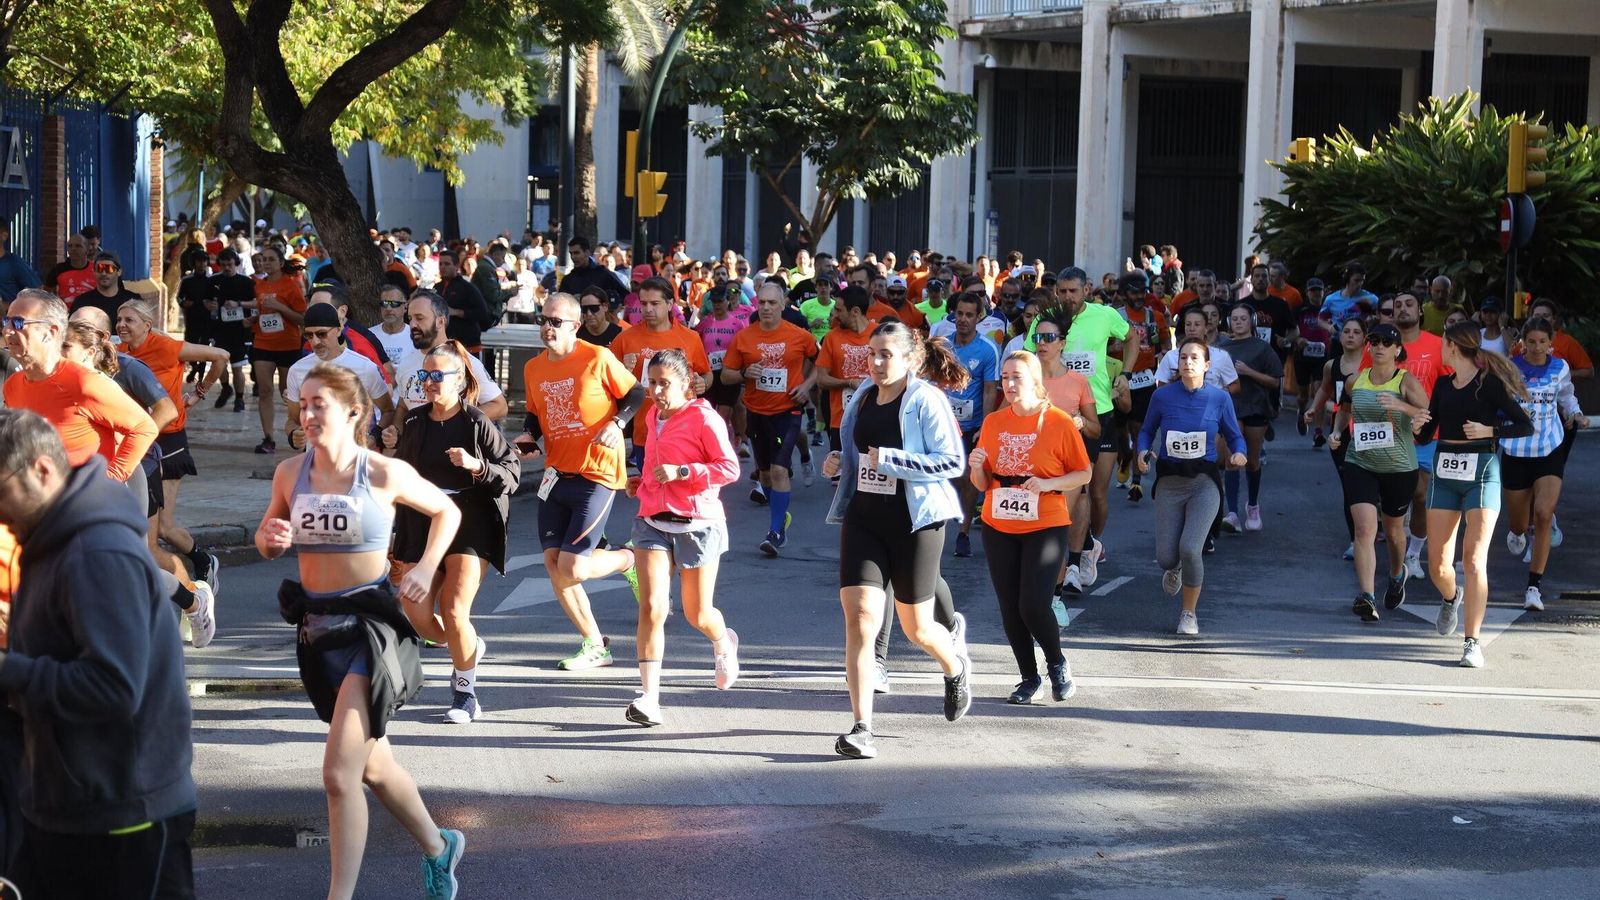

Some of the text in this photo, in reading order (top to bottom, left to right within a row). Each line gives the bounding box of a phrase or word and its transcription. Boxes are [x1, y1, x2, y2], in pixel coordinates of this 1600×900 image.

[1066, 360, 1090, 370] 522
[760, 376, 782, 385] 617
[1360, 431, 1386, 441] 890
[1172, 441, 1199, 450] 618
[1442, 459, 1468, 470] 891
[1000, 499, 1030, 513] 444
[301, 512, 348, 531] 210
